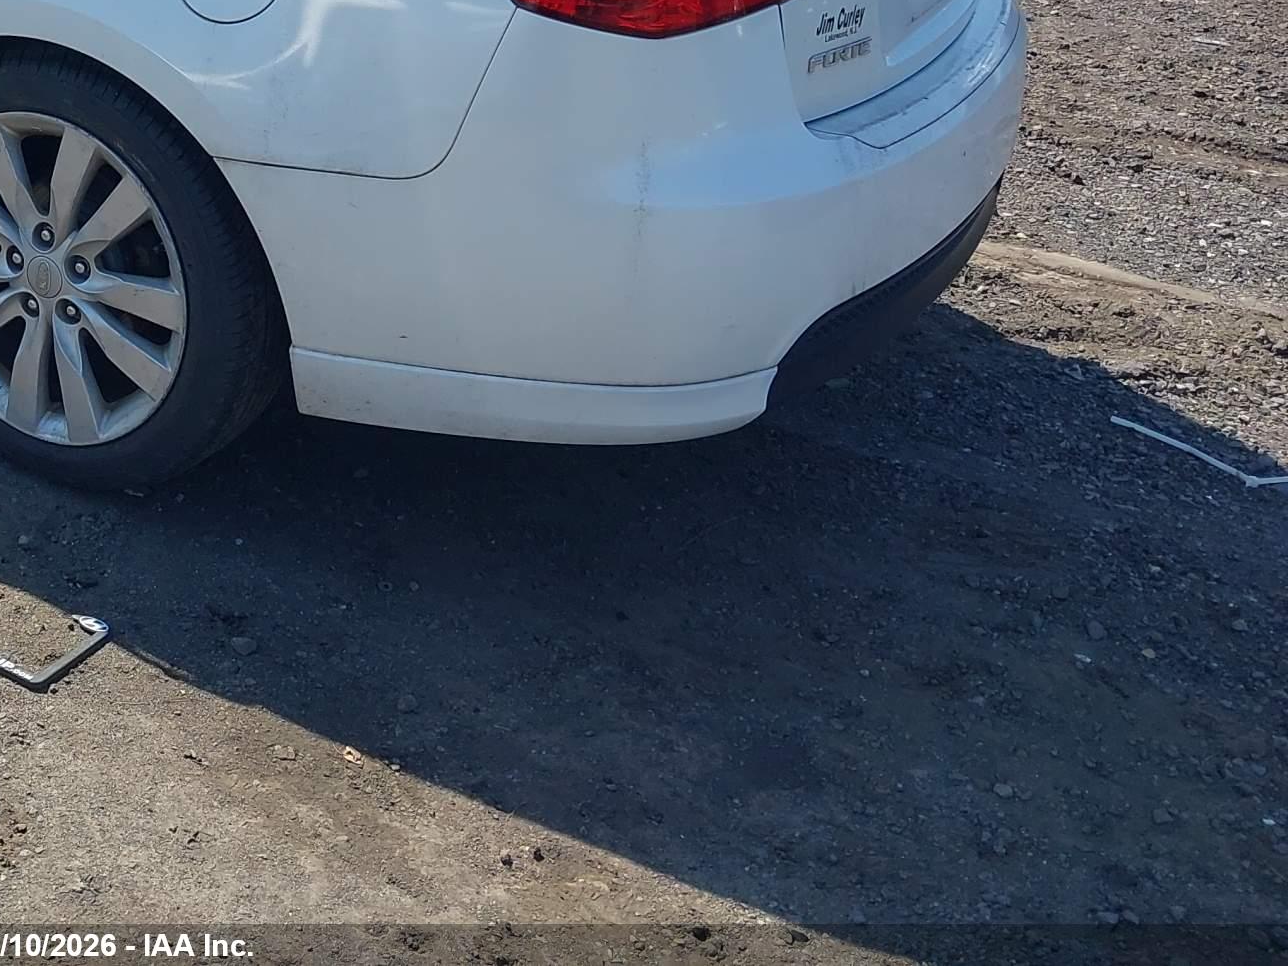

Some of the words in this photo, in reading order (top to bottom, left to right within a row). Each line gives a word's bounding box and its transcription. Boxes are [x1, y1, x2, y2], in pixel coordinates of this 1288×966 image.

[816, 11, 836, 36] Jim
[837, 4, 867, 30] Curley
[807, 36, 873, 74] FORTE
